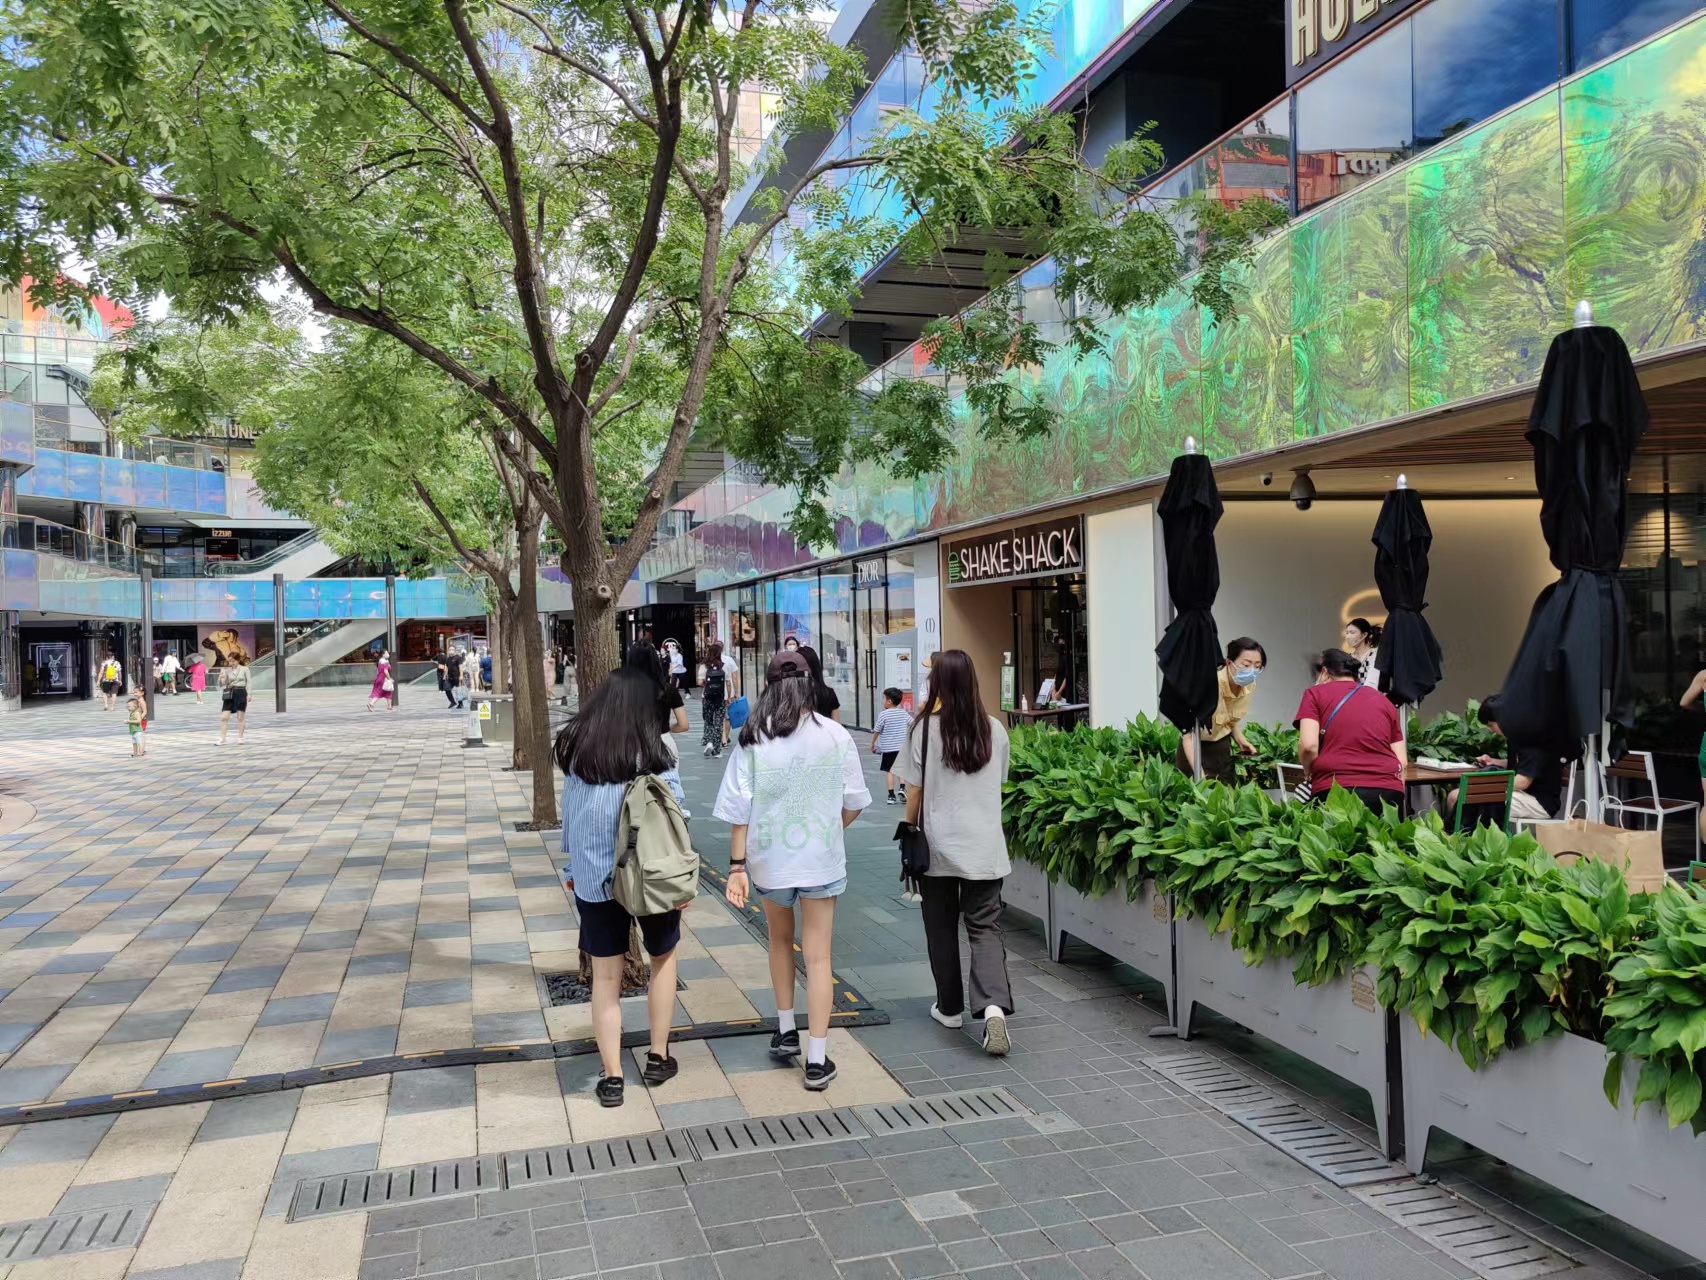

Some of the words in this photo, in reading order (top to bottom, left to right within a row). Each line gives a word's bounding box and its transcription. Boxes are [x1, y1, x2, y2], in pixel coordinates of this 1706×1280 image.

[212, 528, 232, 537] izzue
[960, 540, 1011, 578] SHAKE
[1013, 527, 1076, 572] SHACK
[858, 561, 879, 584] DIOR
